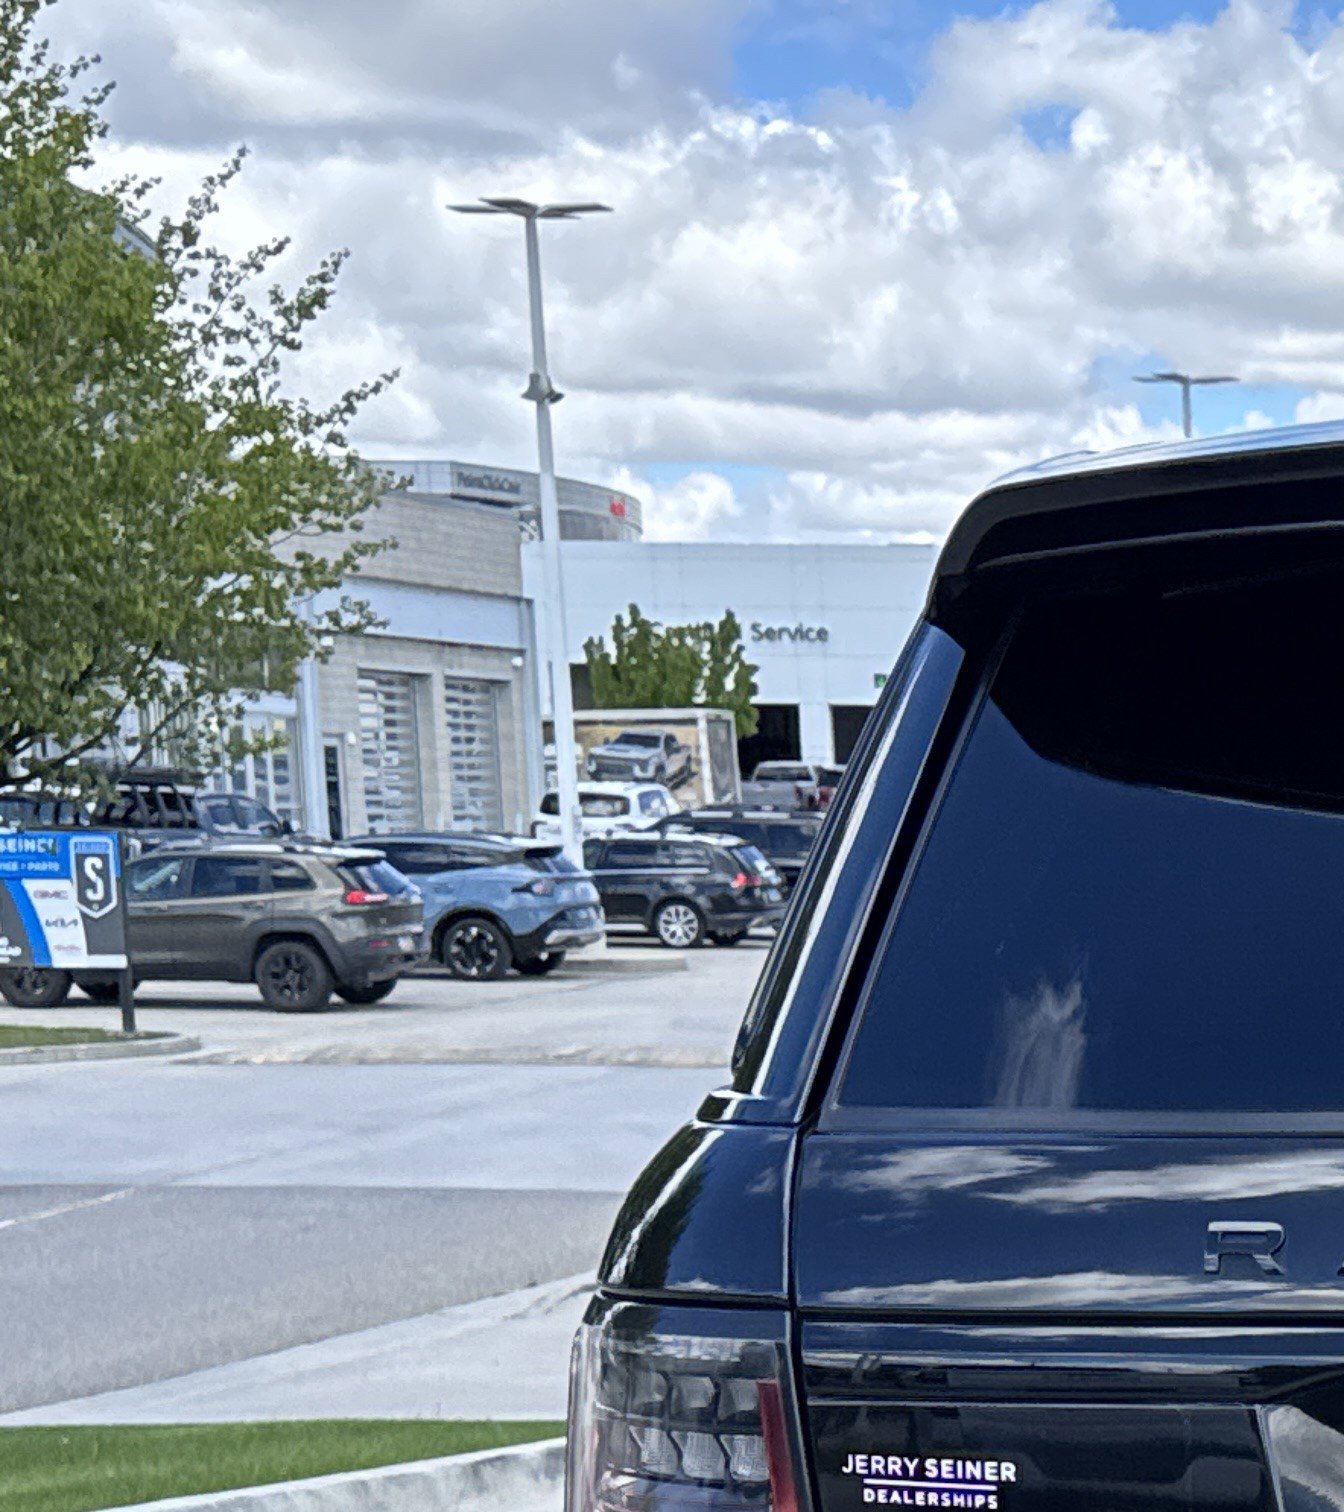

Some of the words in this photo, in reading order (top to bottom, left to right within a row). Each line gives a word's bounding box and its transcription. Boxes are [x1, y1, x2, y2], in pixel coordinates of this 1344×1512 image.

[750, 622, 829, 643] Service
[841, 1453, 919, 1477] JERRY
[924, 1458, 1017, 1483] SEINER
[862, 1488, 999, 1510] DEALERSHIPS
